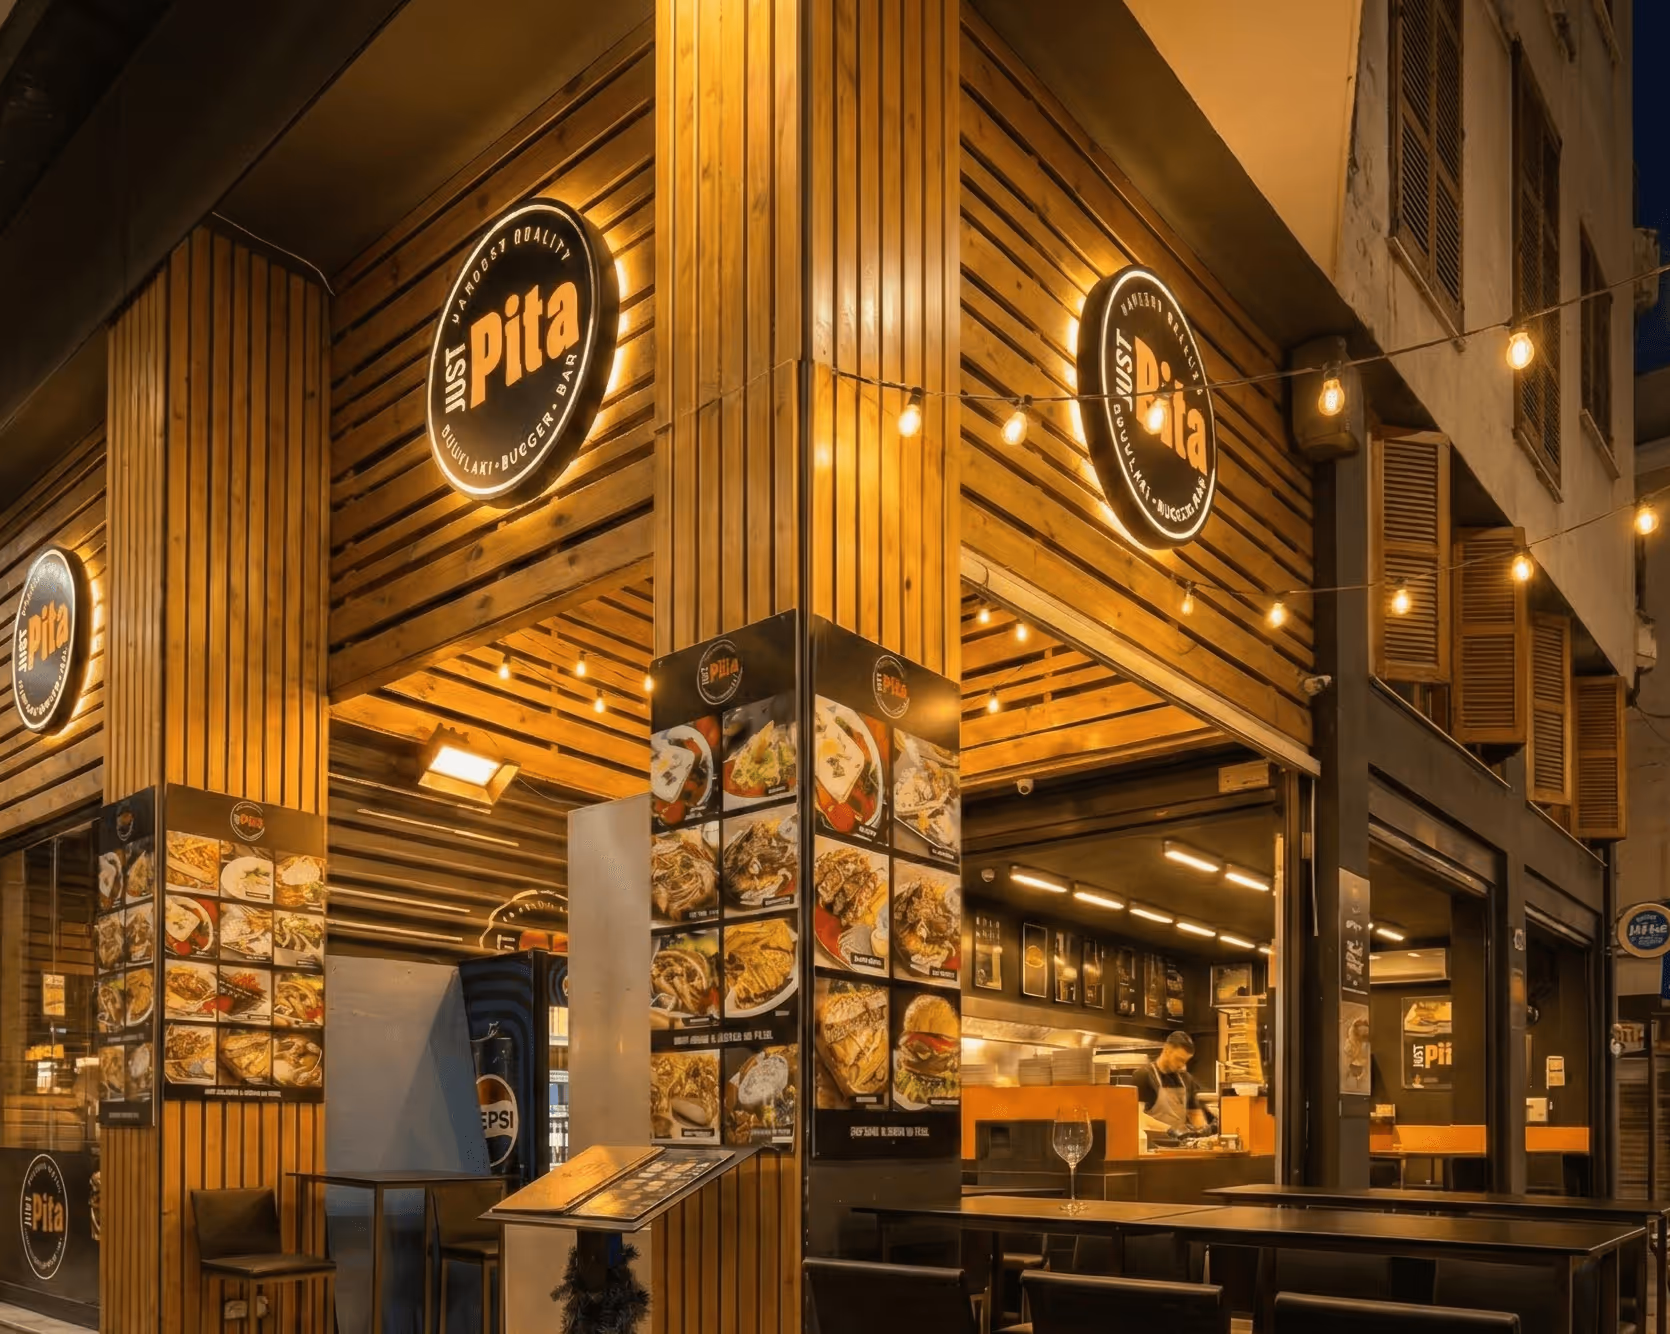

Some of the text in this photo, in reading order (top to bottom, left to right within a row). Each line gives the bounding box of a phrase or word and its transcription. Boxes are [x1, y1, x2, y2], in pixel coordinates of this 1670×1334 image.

[445, 343, 466, 414] JUST
[469, 281, 579, 410] Pita
[555, 354, 578, 397] BAR
[1115, 328, 1133, 412] JUST
[28, 600, 69, 671] Pita
[480, 1110, 514, 1130] EPSI
[32, 1192, 64, 1233] Pita
